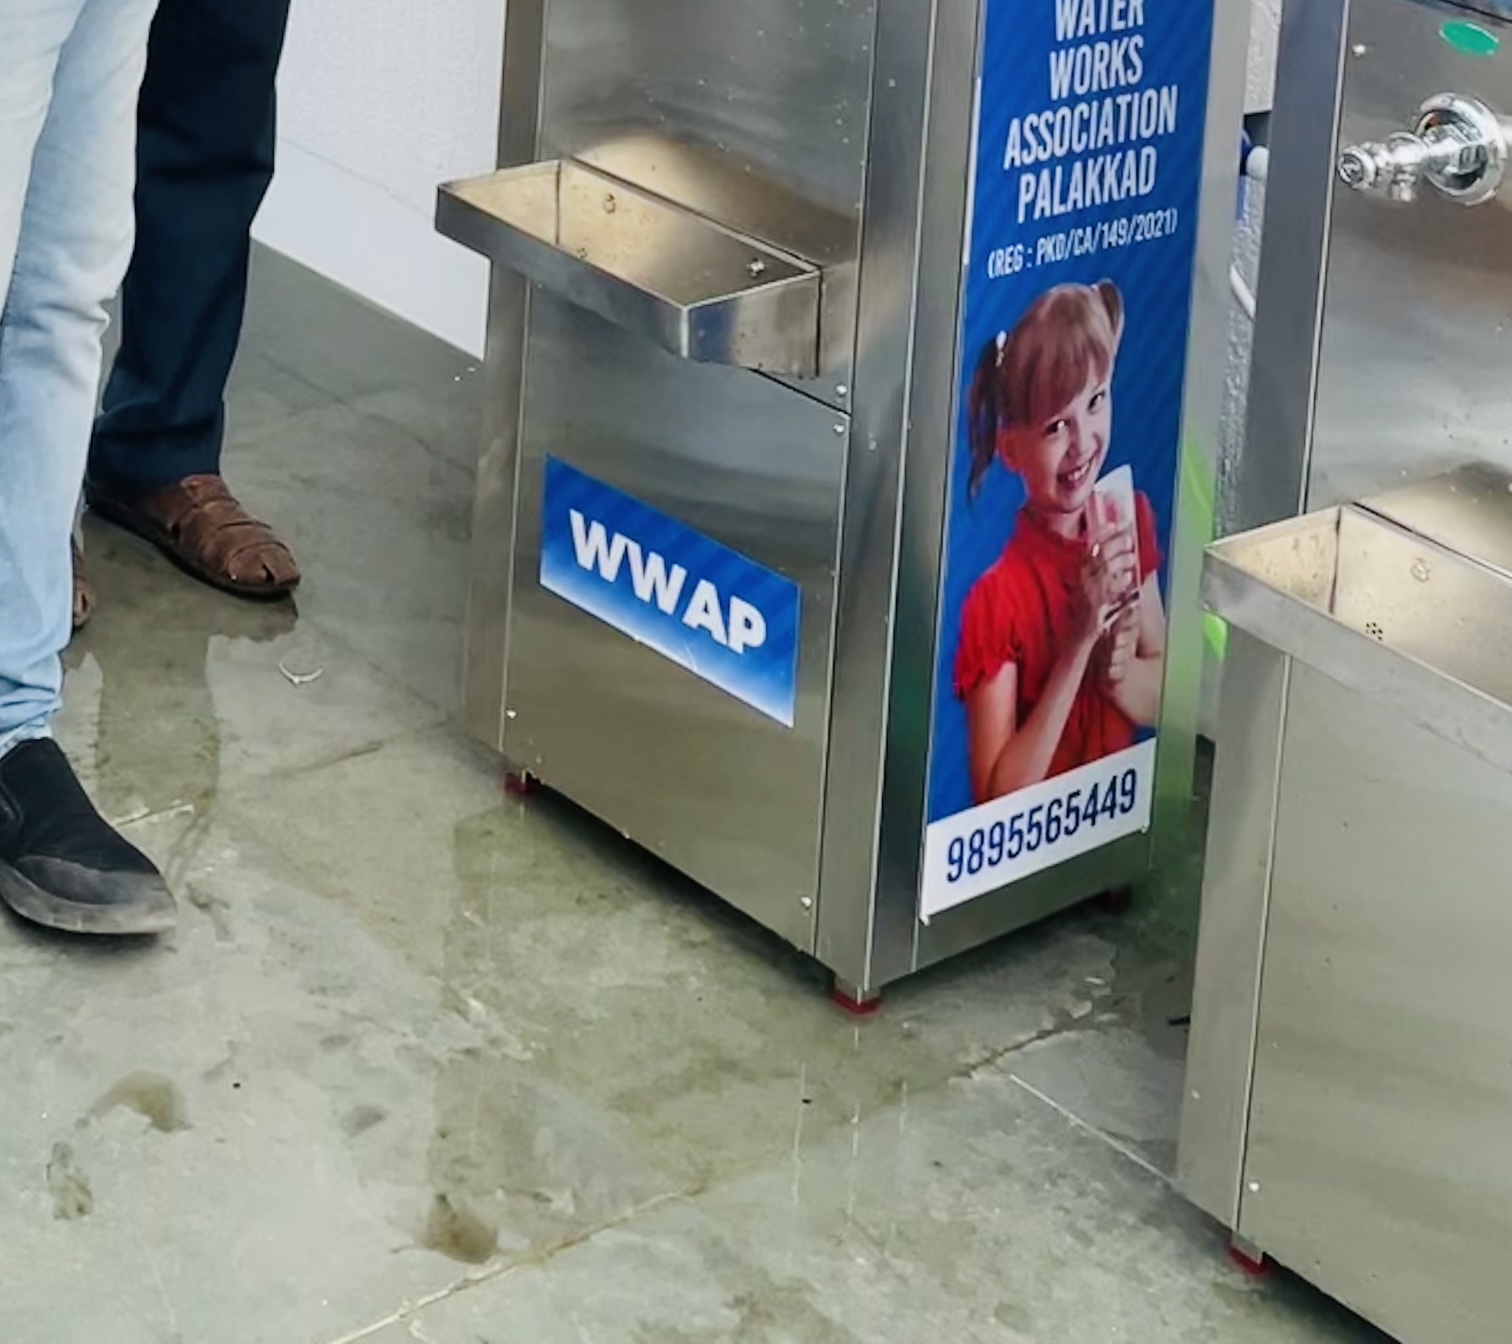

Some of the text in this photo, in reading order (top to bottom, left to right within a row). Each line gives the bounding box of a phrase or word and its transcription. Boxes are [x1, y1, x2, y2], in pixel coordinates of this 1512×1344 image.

[1049, 36, 1144, 102] WORKS
[1004, 84, 1179, 171] ASSOCIATION
[1017, 146, 1157, 224] PALAKKAD
[1036, 207, 1178, 266] PKD/CA/149/2021)
[569, 508, 768, 655] WWAP
[946, 766, 1138, 884] 9895565449
